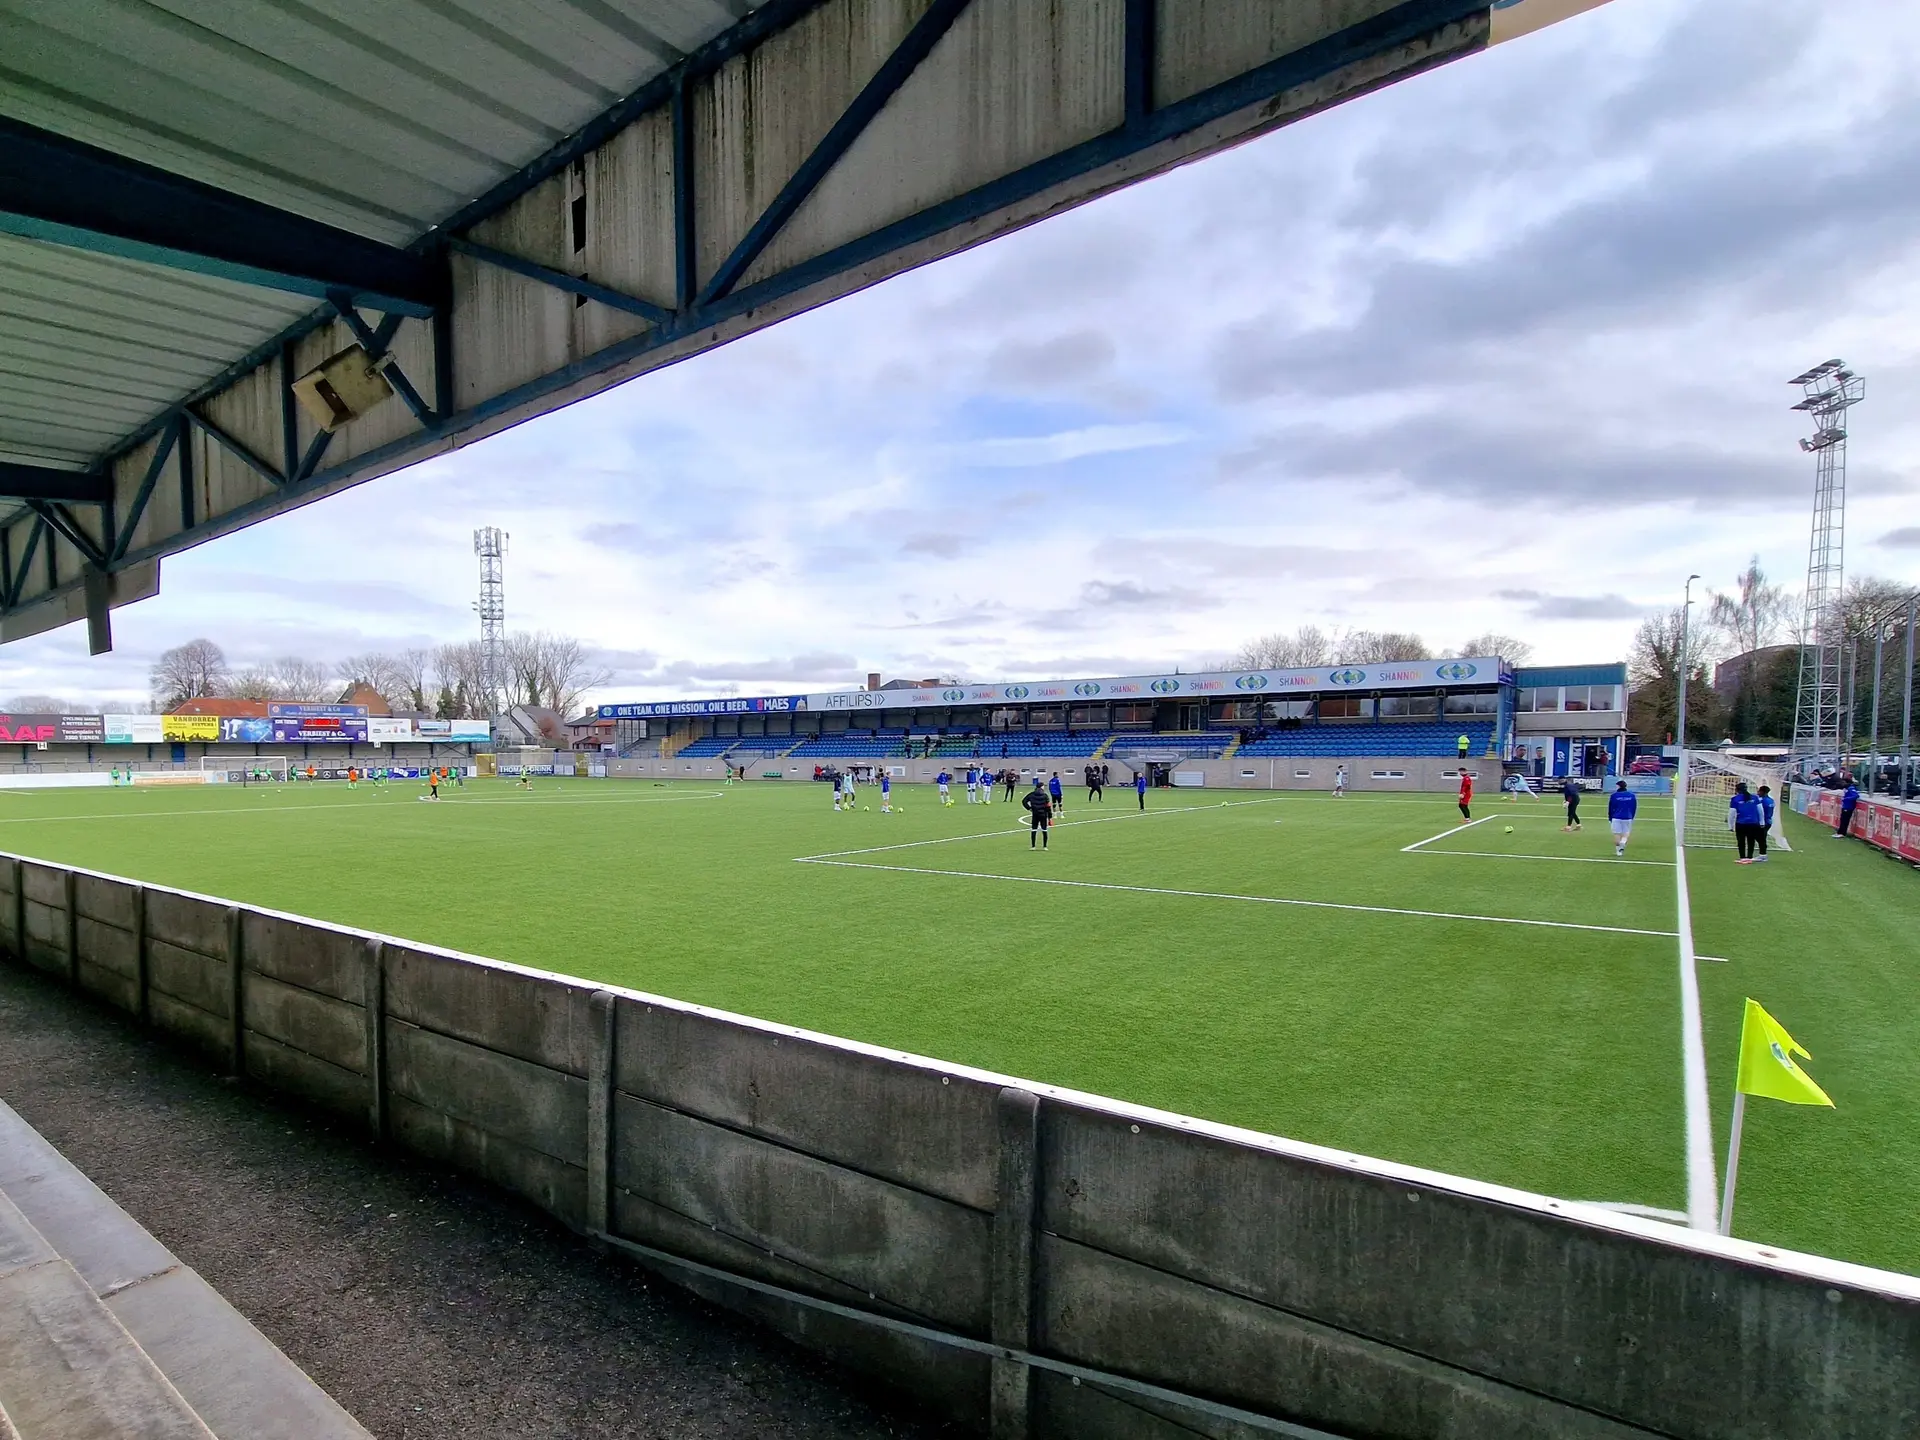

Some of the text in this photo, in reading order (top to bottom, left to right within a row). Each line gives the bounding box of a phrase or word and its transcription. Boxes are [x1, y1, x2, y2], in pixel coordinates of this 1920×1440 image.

[1279, 676, 1318, 686] SHANNON
[1379, 670, 1422, 682] SHANNON
[1190, 681, 1225, 690] SHANNON
[764, 698, 790, 711] MAES
[825, 694, 872, 708] AFFILIPS
[618, 700, 750, 716] ONE TEAM. ONE MISSION. ONE BEER.
